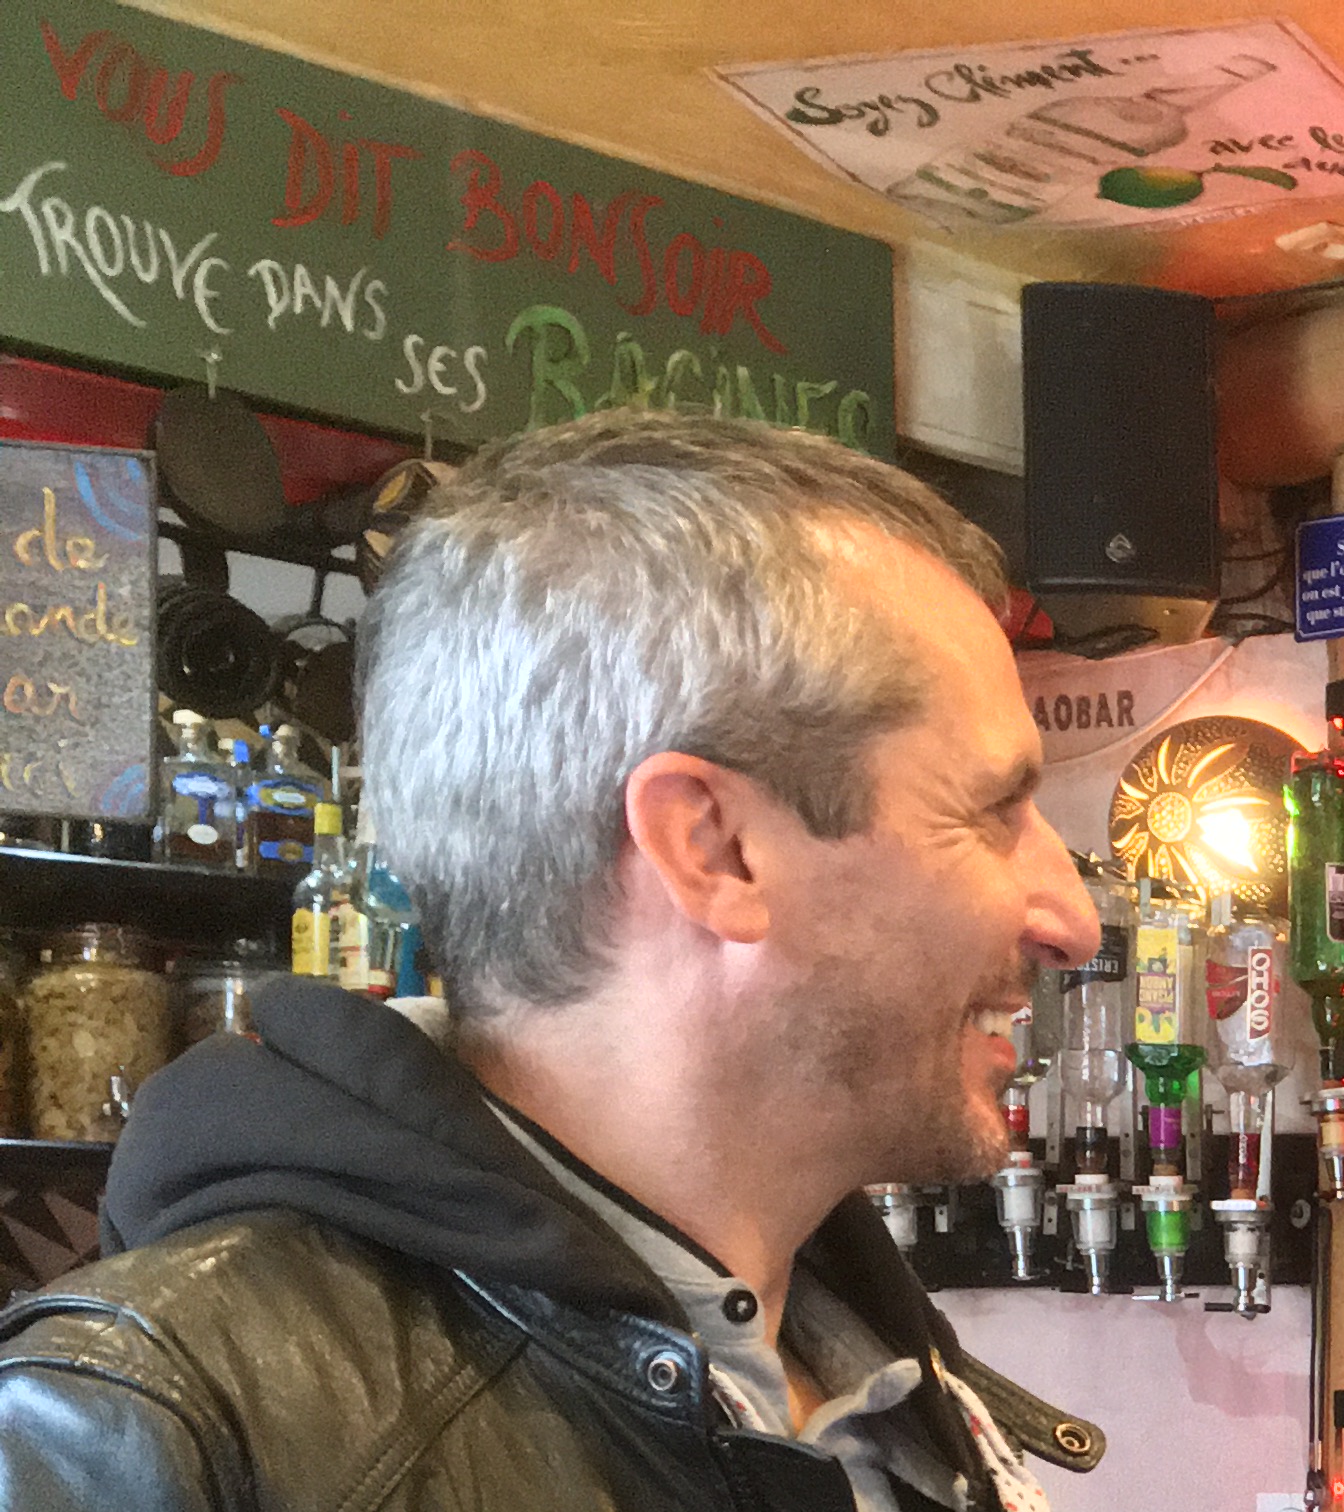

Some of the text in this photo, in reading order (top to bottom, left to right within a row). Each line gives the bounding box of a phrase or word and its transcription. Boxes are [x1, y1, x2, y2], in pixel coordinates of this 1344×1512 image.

[786, 87, 939, 136] Soyez
[1206, 133, 1294, 156] avec
[40, 18, 788, 355] VOUS DIT BONSOIR
[2, 162, 233, 334] TROUVE
[249, 258, 389, 341] DANS
[395, 334, 488, 413] SES
[1301, 589, 1320, 602] on
[1321, 585, 1341, 599] est
[1302, 567, 1329, 584] que
[1306, 607, 1332, 626] que
[1033, 688, 1135, 732] AOBAR
[1250, 951, 1272, 1034] SOHO
